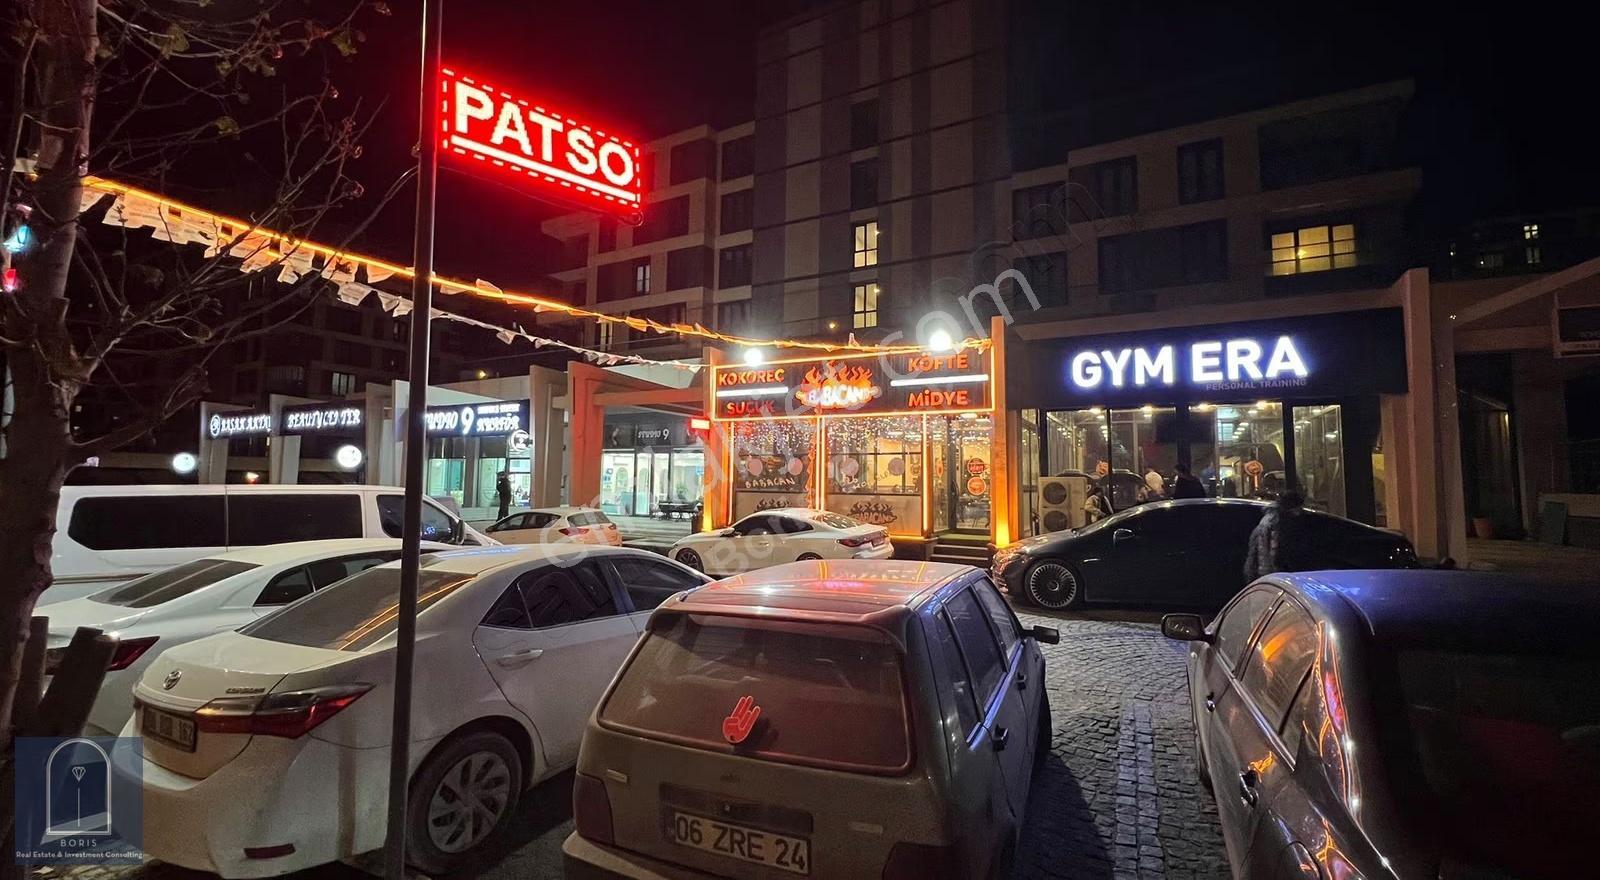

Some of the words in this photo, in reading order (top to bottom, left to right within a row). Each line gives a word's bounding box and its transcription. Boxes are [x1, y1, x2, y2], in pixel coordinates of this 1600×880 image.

[455, 81, 635, 187] PATSO
[908, 352, 969, 373] KÖFTE
[1071, 345, 1174, 388] GYM
[1191, 335, 1309, 383] ERA
[1206, 380, 1257, 392] PERSONAL
[1259, 377, 1308, 389] TRAINING
[461, 406, 475, 435] 9
[662, 428, 670, 440] 9
[674, 813, 703, 846] 06
[711, 826, 766, 862] ZRE
[774, 838, 808, 871] 24
